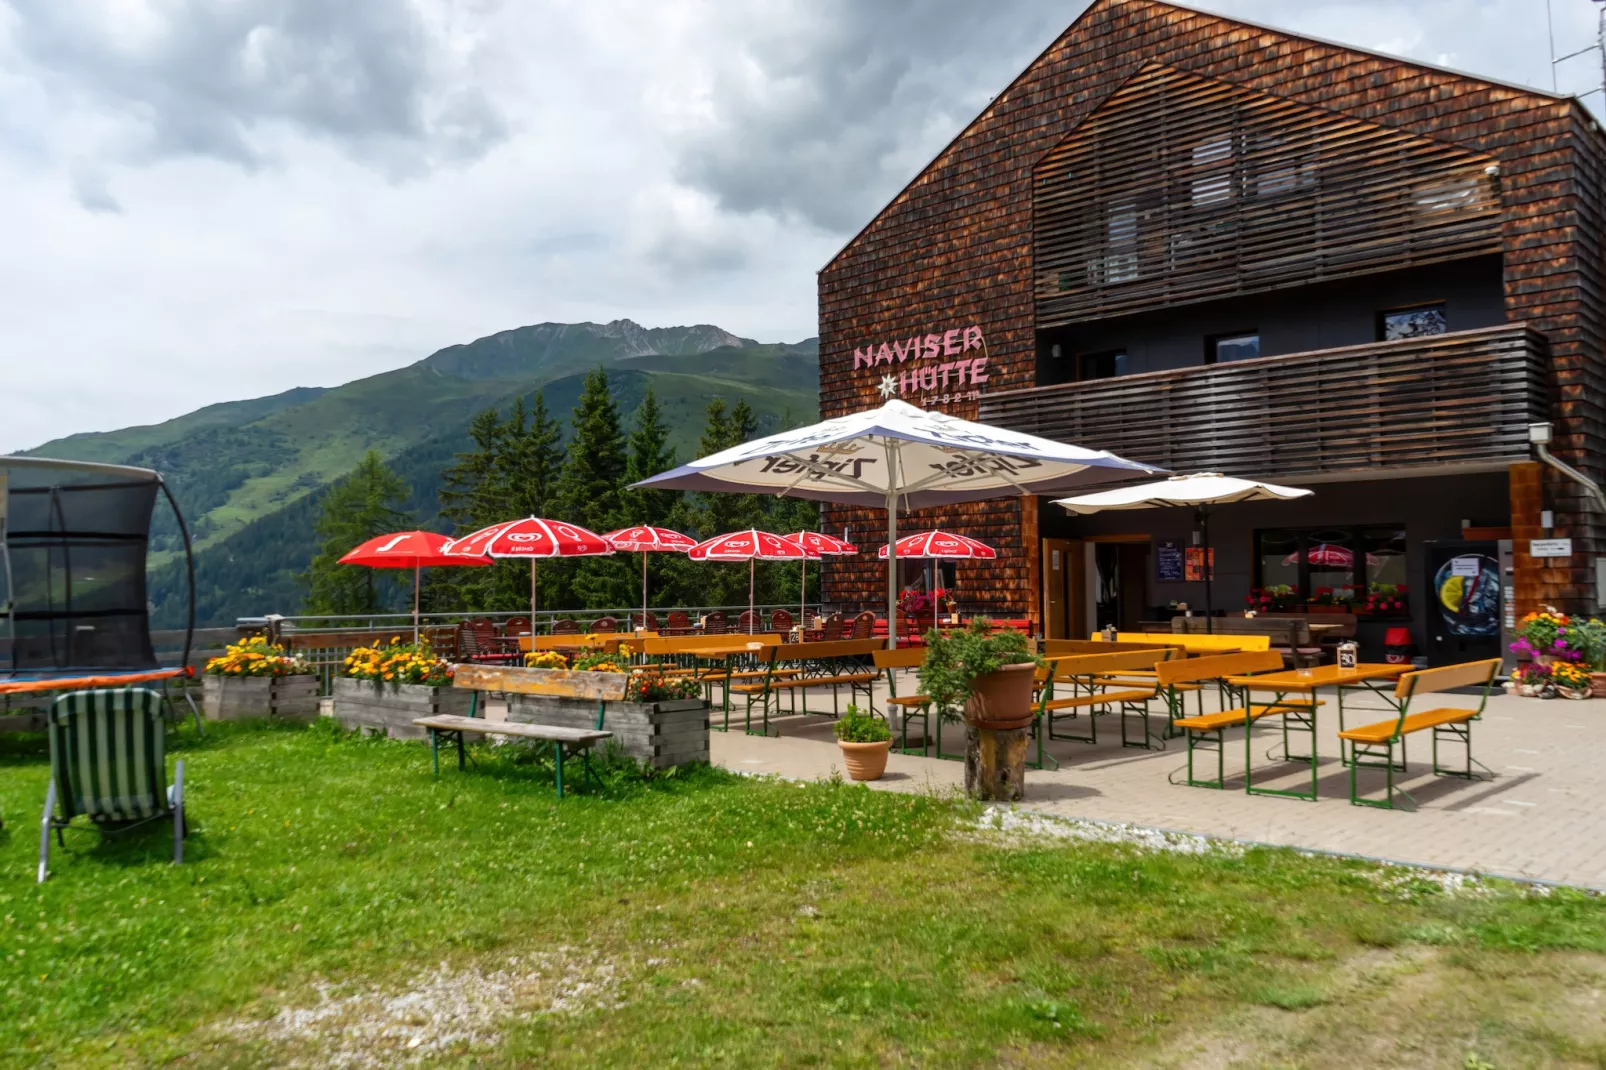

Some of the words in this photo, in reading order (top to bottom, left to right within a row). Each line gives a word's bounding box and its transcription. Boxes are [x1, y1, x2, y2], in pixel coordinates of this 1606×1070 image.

[853, 325, 982, 370] NAVISER
[899, 357, 990, 395] HÜTTE
[921, 392, 962, 407] 1782
